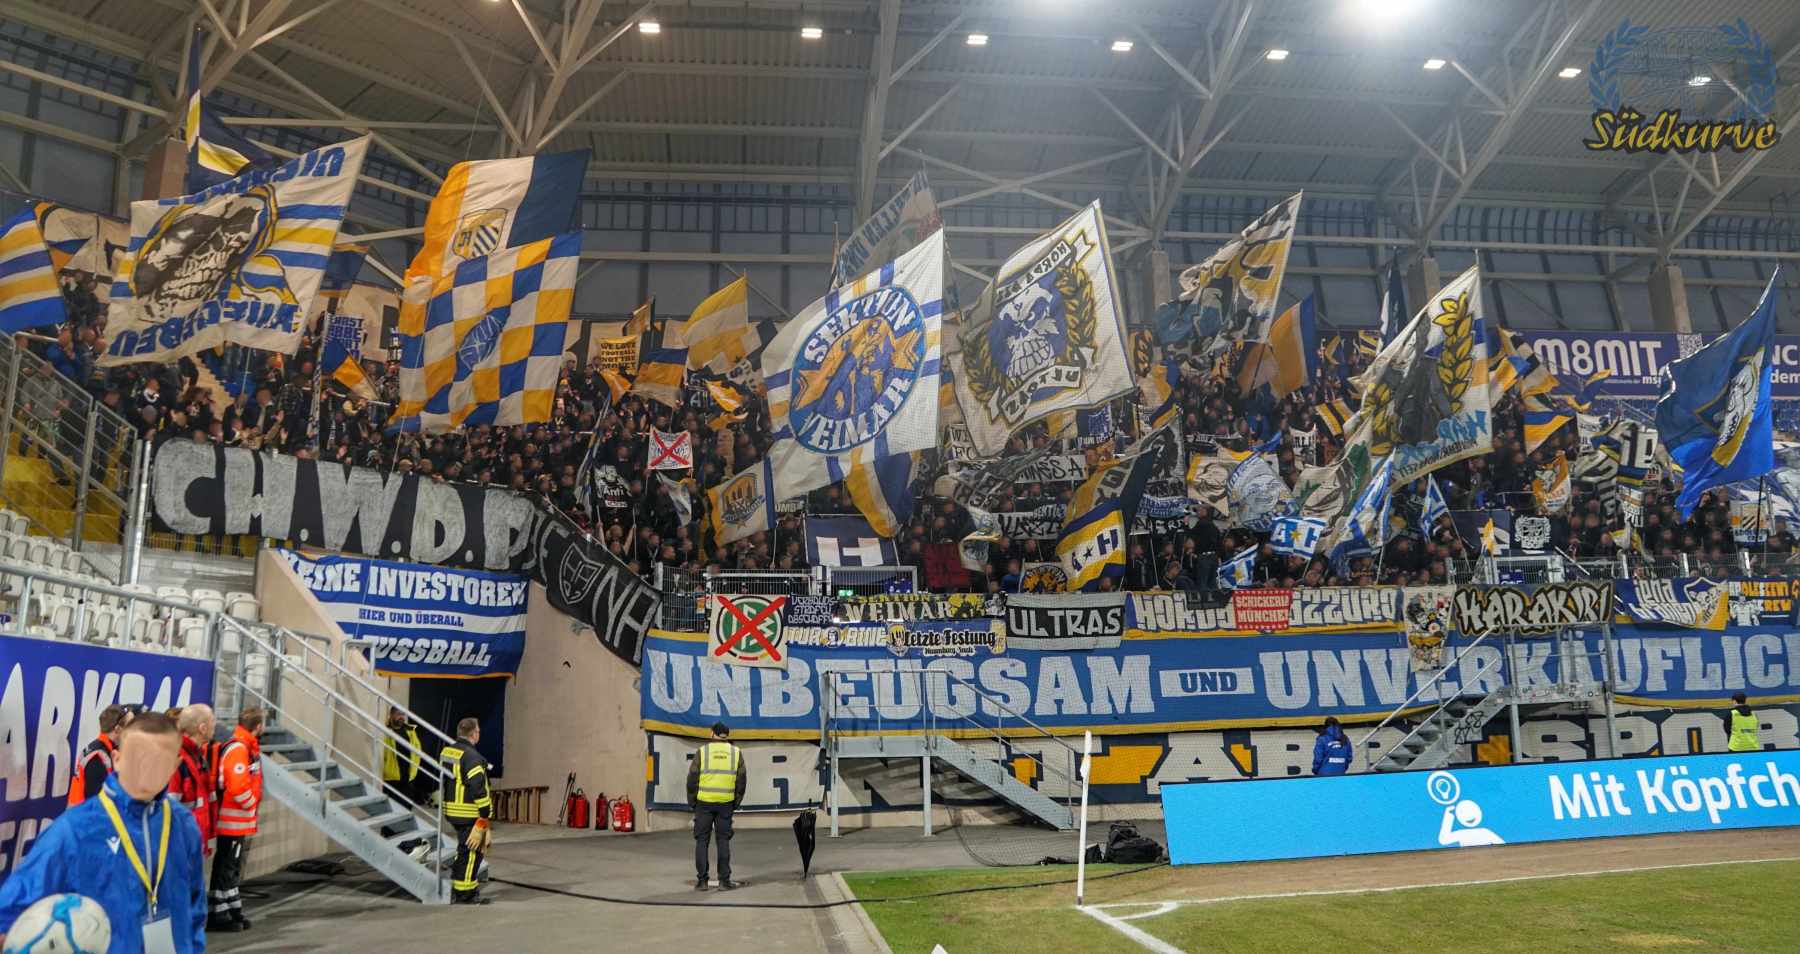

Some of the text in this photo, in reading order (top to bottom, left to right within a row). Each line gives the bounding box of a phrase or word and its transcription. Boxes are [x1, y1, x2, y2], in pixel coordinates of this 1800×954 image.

[369, 563, 528, 605] INVESTOREN
[358, 609, 465, 627] HIER UND ÜBERALL
[845, 601, 950, 622] WEIMAR
[1009, 608, 1121, 637] ULTRAS
[1455, 586, 1610, 632] HARAKIRI
[904, 628, 997, 647] letzte Festung
[647, 632, 1800, 720] UNBEUGSAM UND UNVERKÄUFLIC
[1549, 771, 1632, 820] Mit
